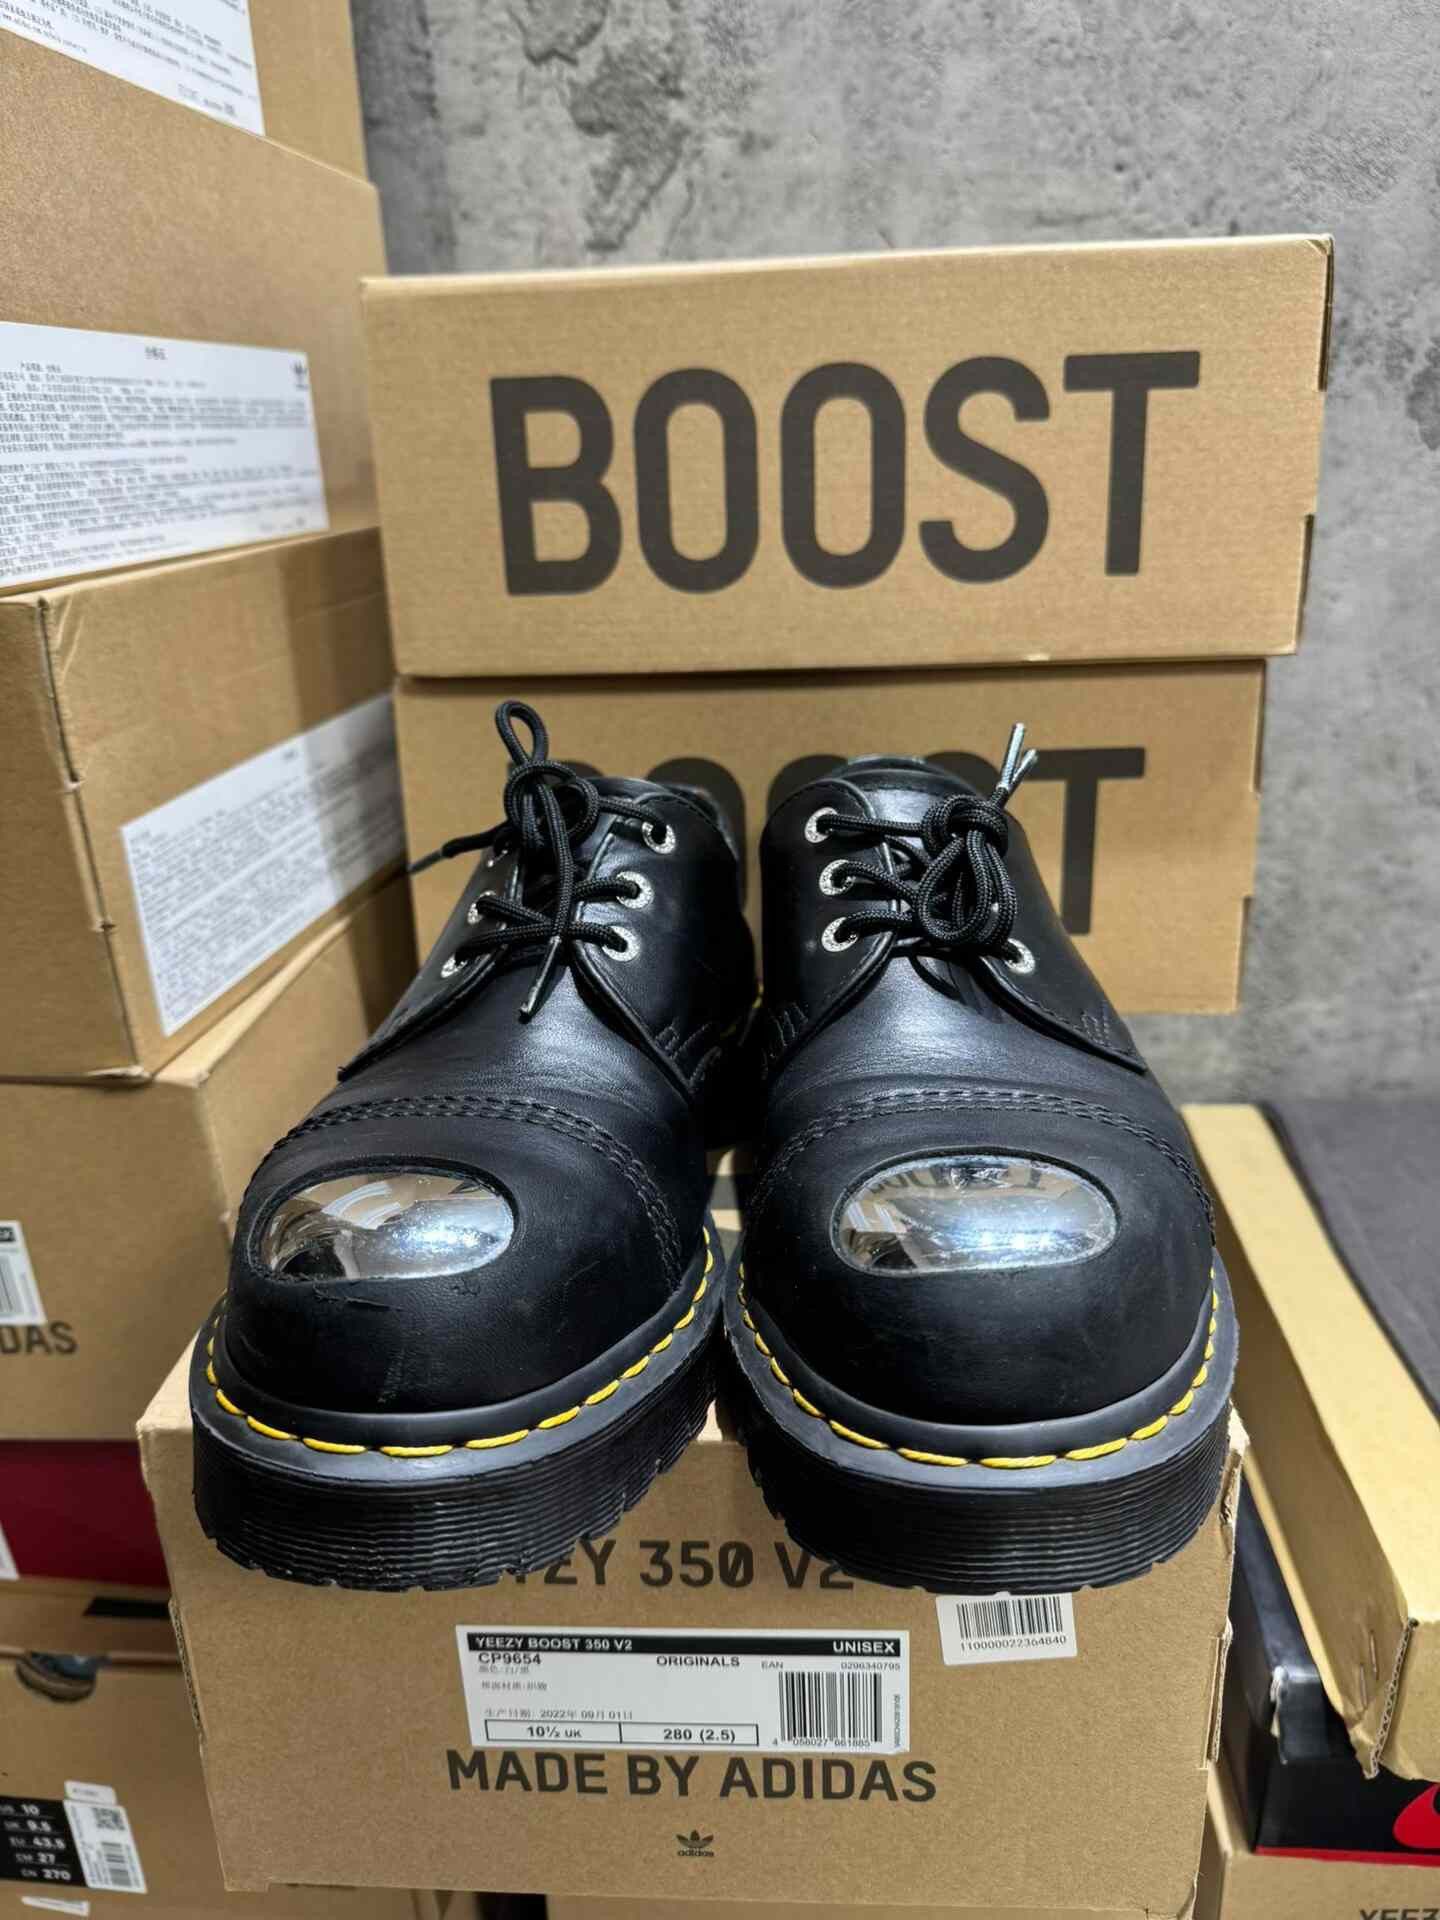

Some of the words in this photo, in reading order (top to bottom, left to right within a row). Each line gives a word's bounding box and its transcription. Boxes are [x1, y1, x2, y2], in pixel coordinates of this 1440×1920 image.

[490, 350, 1201, 596] BOOST
[640, 1541, 755, 1588] 350
[475, 1636, 524, 1649] YEEZY
[528, 1638, 581, 1650] BOOST
[585, 1639, 610, 1650] 350
[614, 1640, 633, 1651] V2
[833, 1641, 896, 1654] UNISEX
[478, 1652, 542, 1666] CP9654
[656, 1655, 741, 1668] ORIGINALS
[761, 1661, 784, 1670] EAN
[663, 1728, 693, 1741] 280
[699, 1729, 736, 1742] (2.5)
[447, 1750, 608, 1795] MADE
[627, 1754, 700, 1797] BY
[719, 1757, 937, 1803] ADIDAS
[677, 1848, 715, 1858] adidas
